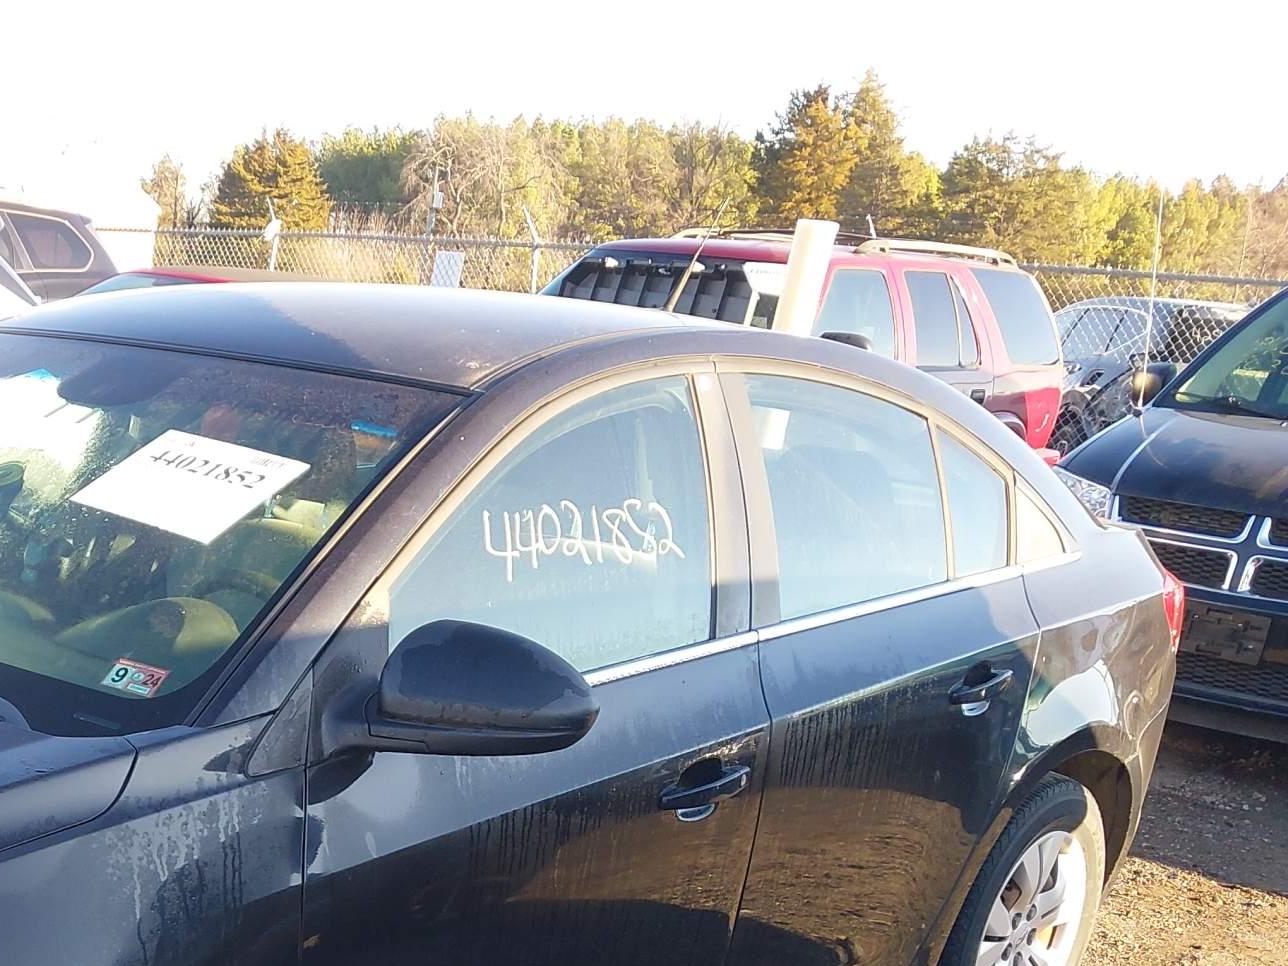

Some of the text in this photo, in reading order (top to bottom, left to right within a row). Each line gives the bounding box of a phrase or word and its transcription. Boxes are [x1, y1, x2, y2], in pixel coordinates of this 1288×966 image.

[150, 450, 266, 489] 44021852
[483, 498, 686, 582] 44021852
[111, 667, 129, 683] 9
[142, 673, 162, 688] 24
